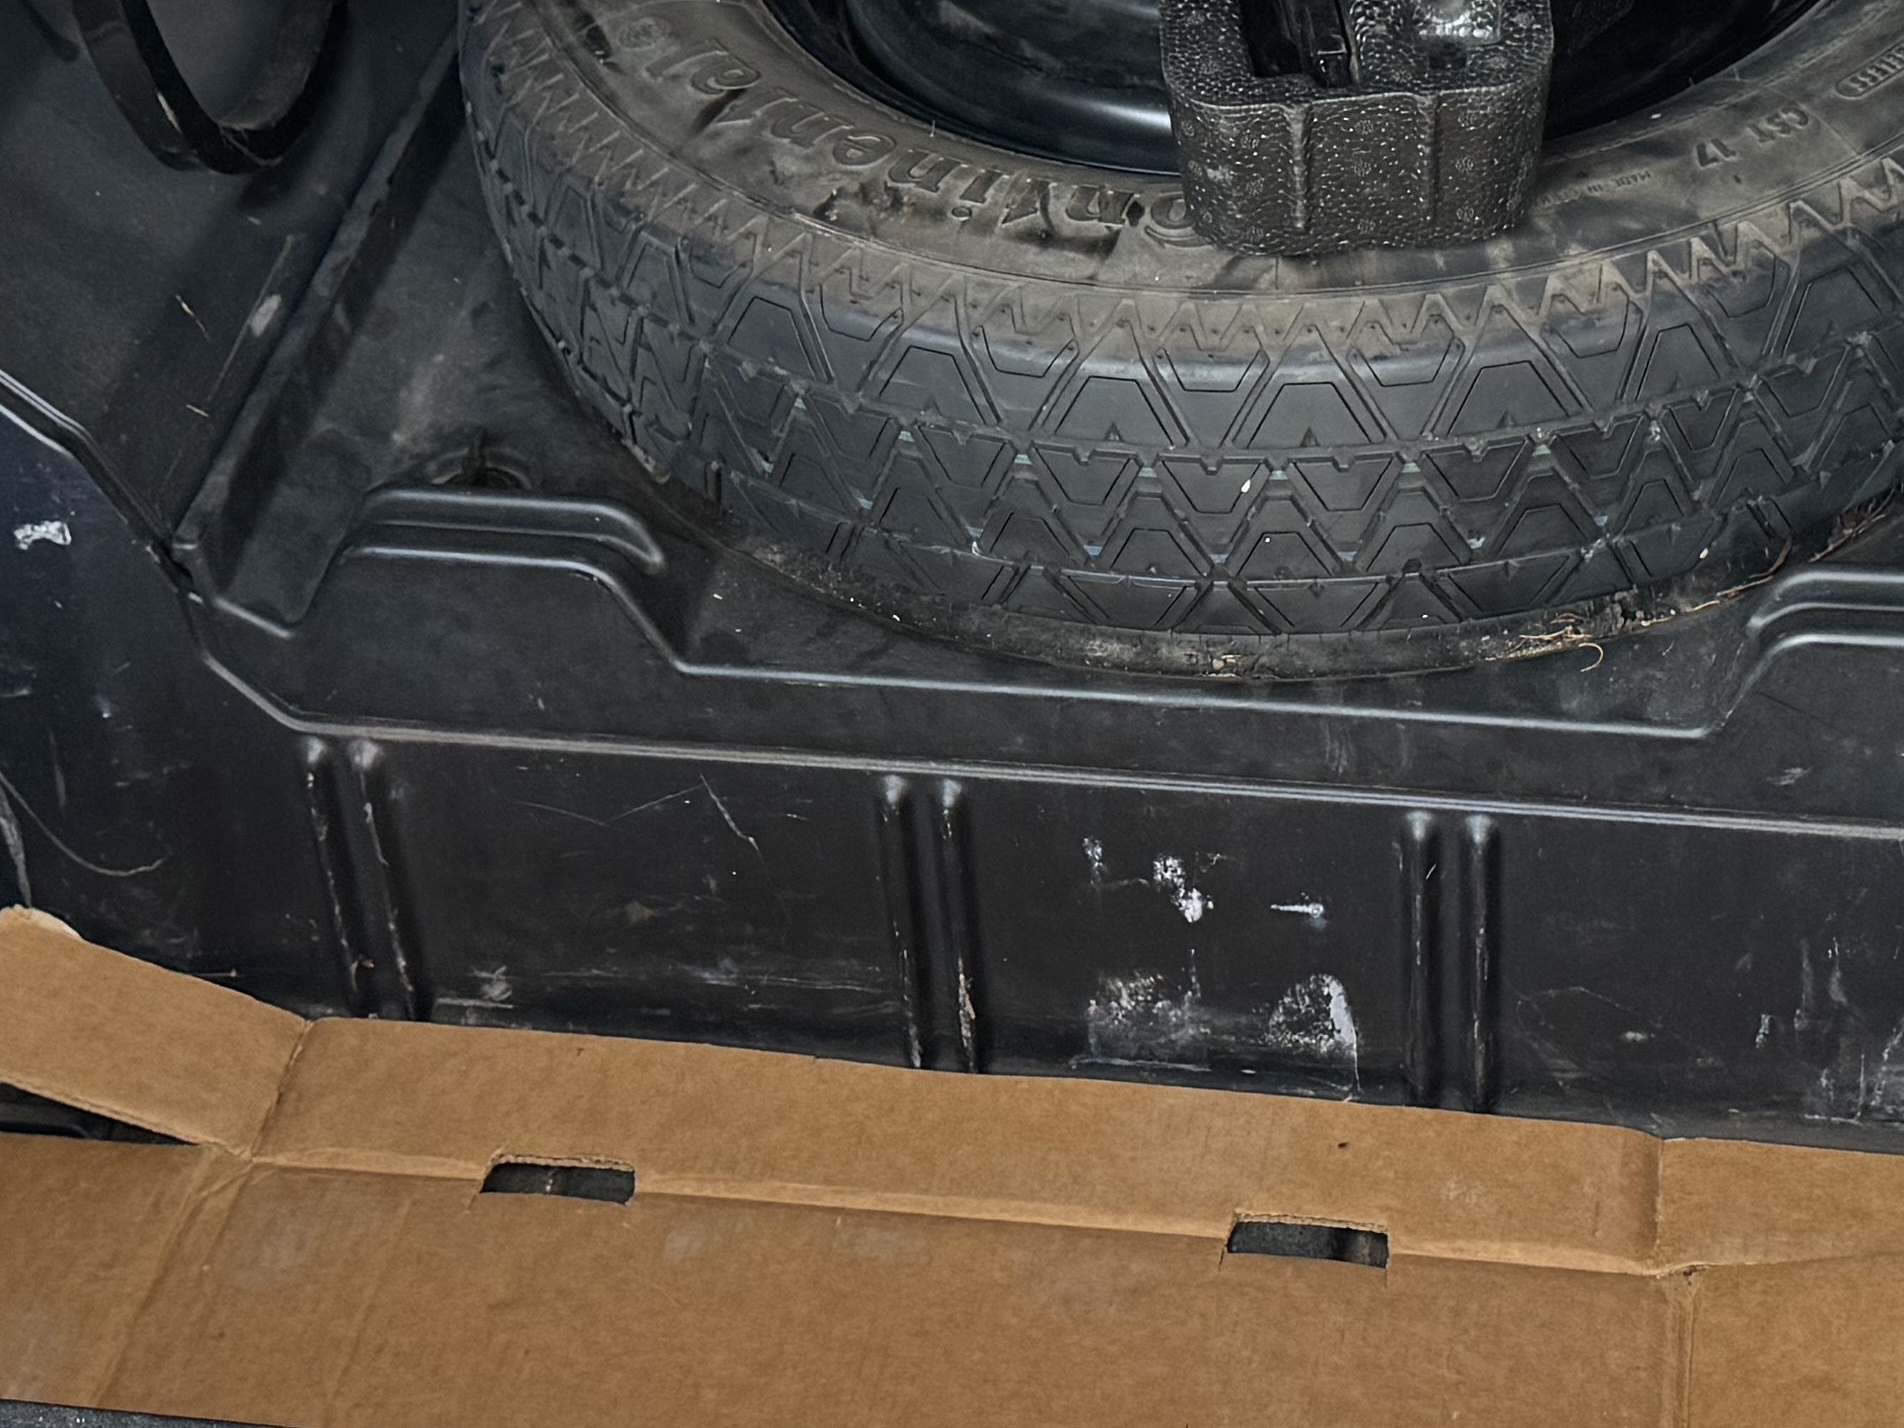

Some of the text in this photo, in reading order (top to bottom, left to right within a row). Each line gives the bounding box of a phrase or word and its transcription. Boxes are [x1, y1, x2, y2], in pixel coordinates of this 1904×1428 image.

[1697, 106, 1809, 167] CST 17
[1586, 182, 1604, 195] IN
[1614, 171, 1652, 189] MADE
